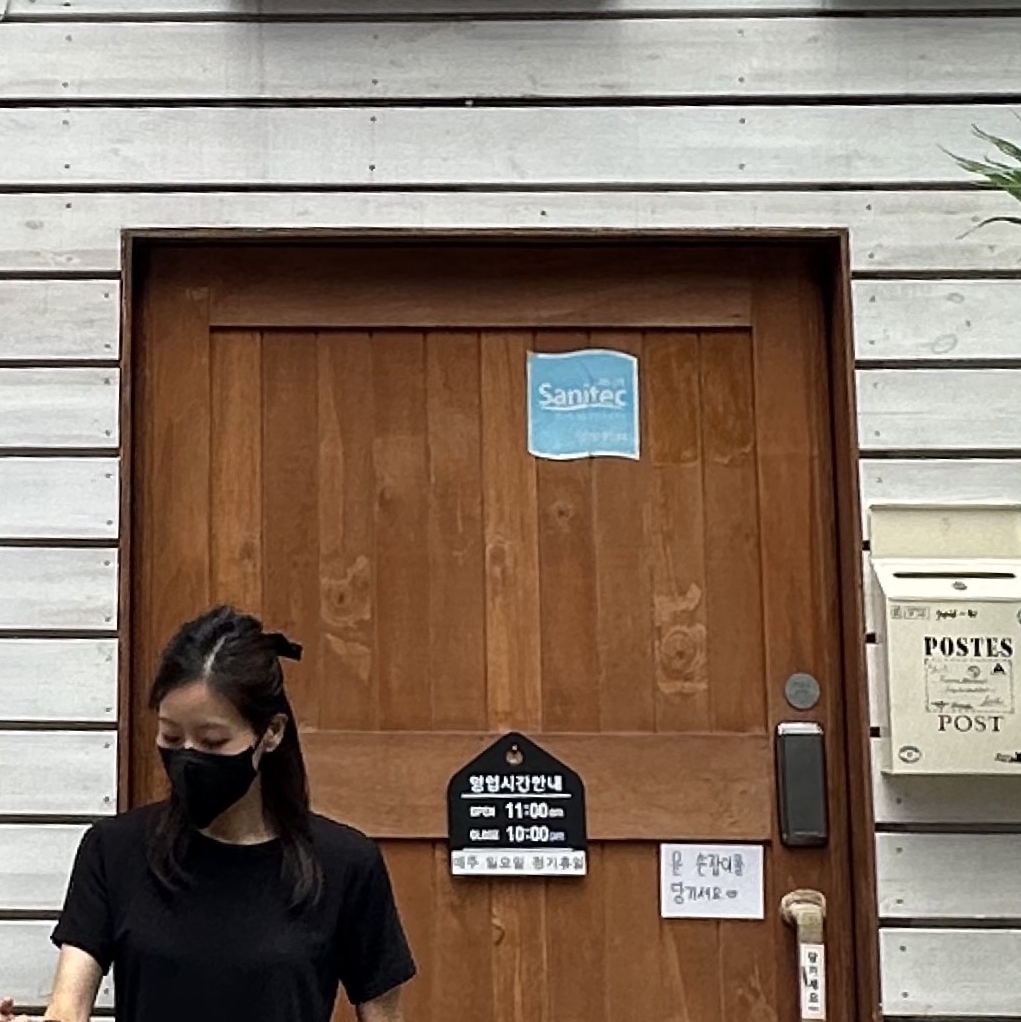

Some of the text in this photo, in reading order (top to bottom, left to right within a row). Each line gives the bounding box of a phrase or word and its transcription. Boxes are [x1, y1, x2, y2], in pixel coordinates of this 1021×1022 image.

[538, 382, 626, 406] Sanitec
[924, 636, 1013, 658] POSTES
[938, 714, 1005, 732] POST
[486, 857, 525, 870] 일요일
